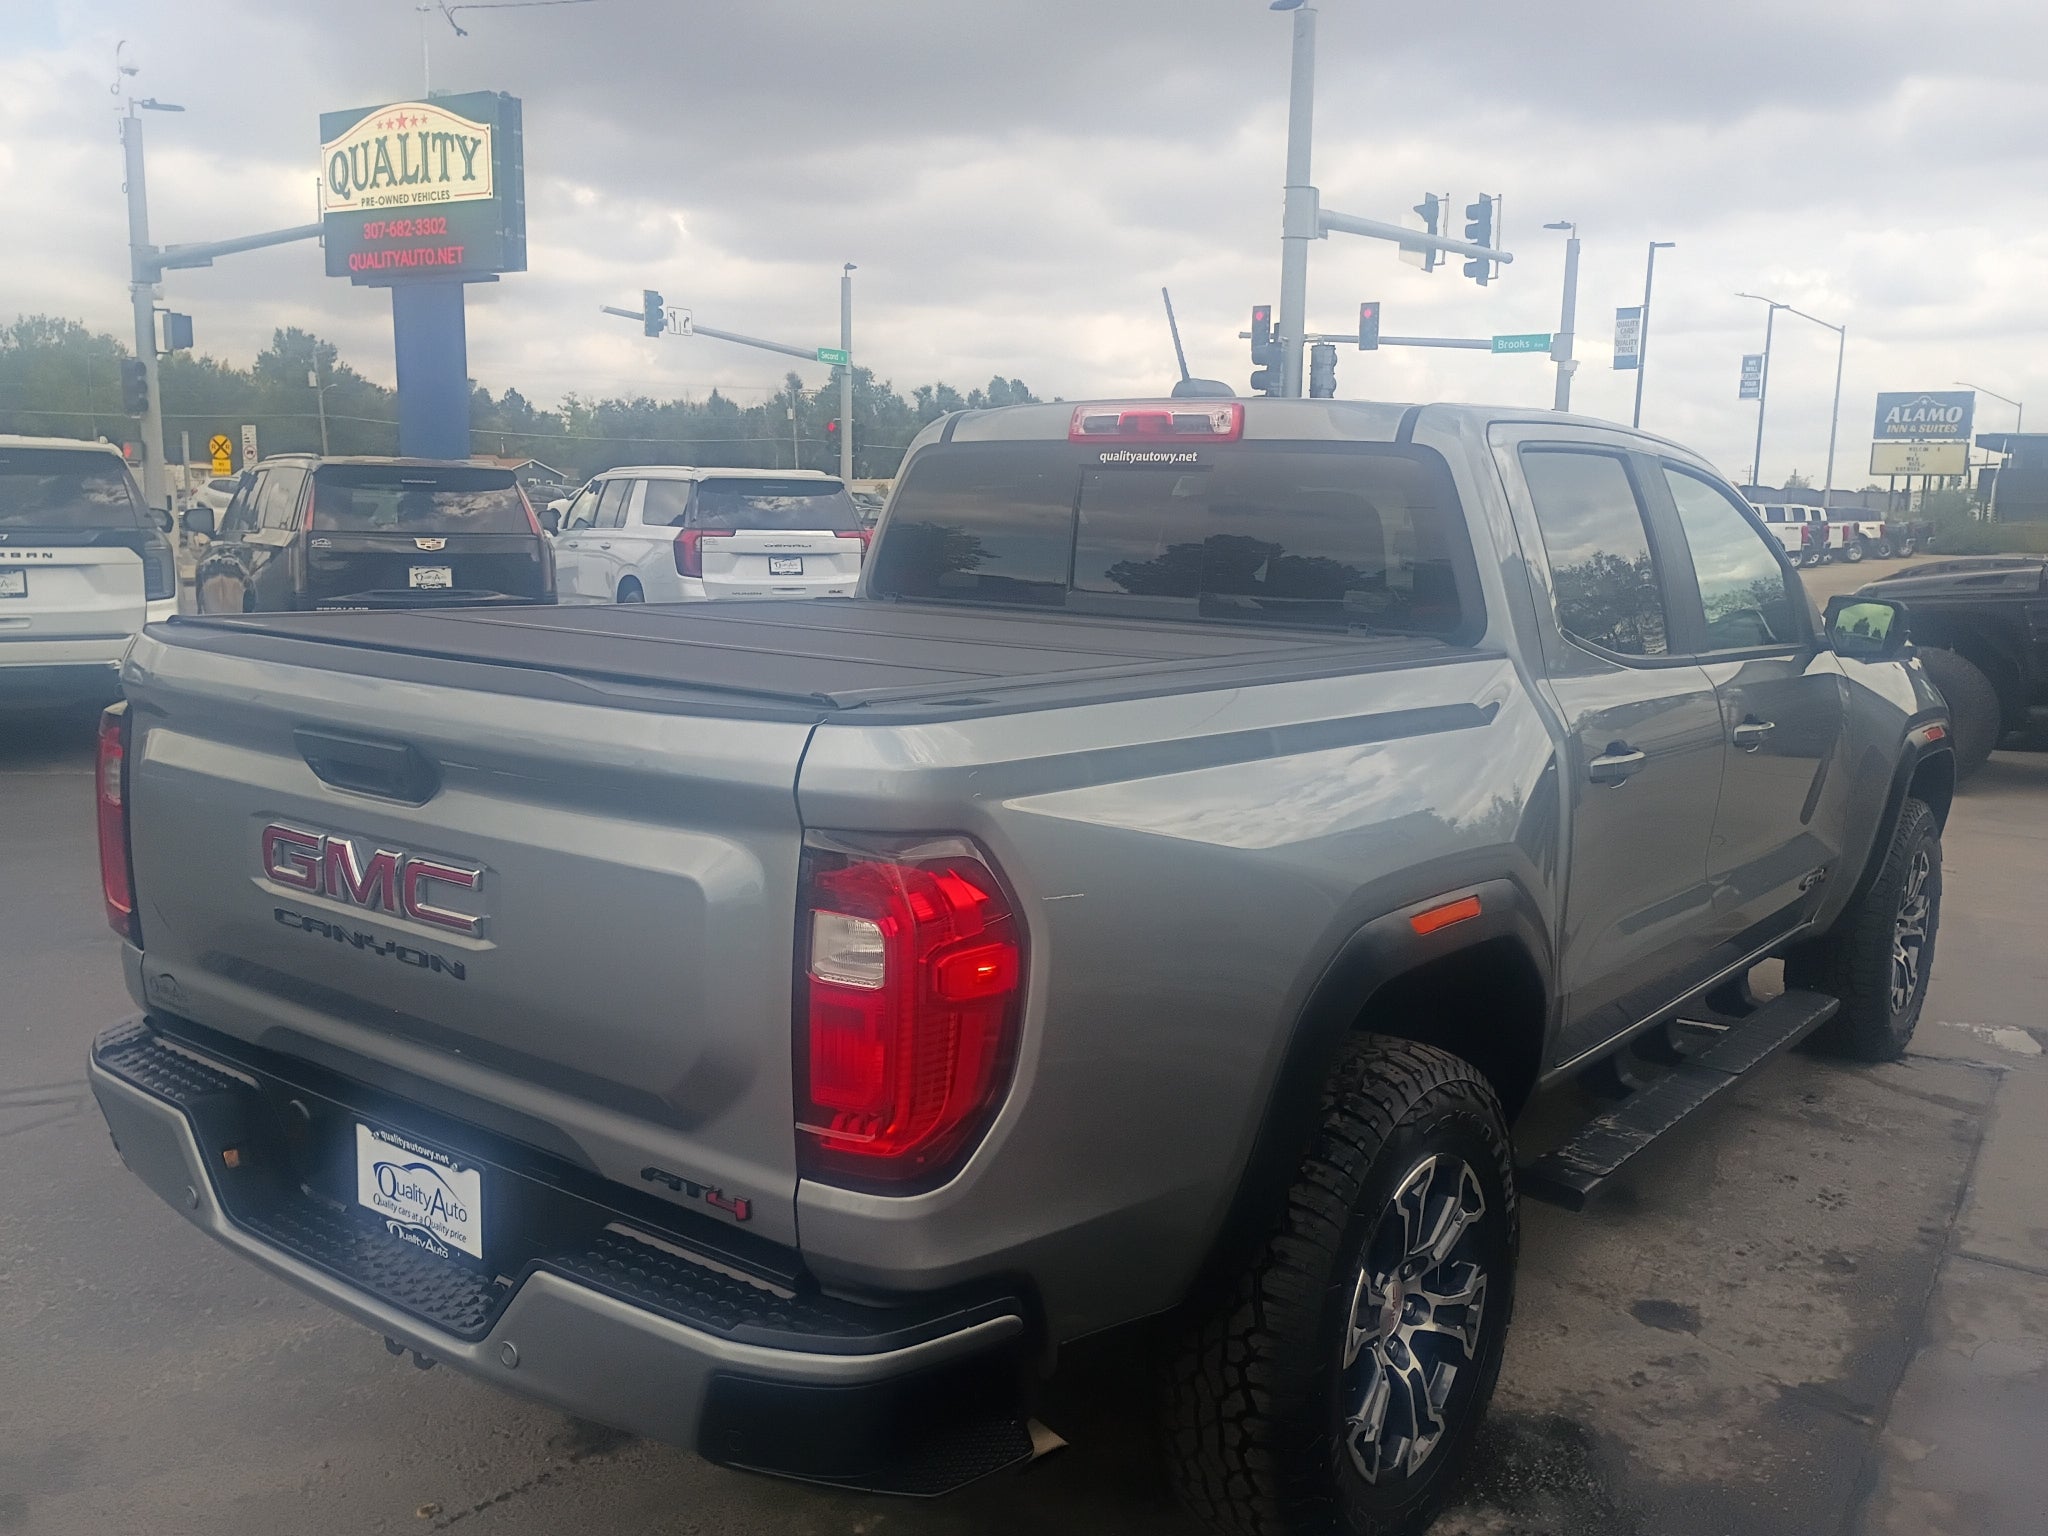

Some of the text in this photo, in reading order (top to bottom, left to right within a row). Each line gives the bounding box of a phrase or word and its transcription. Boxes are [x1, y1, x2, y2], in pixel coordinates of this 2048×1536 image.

[328, 131, 482, 200] QUALITY
[361, 190, 451, 207] PRE-OWNED VEHICLES
[363, 217, 447, 239] 307-682-3302
[349, 246, 464, 271] QUALITYAUTO.NET
[821, 351, 838, 361] Second
[1498, 340, 1530, 349] Brooks
[1885, 406, 1963, 423] ALAMO
[1887, 424, 1959, 433] INN & SUITES
[1100, 450, 1197, 464] qualityautowy.net
[262, 822, 484, 940] GMC
[274, 907, 466, 981] CANYON
[380, 1130, 450, 1164] qualityautowy.net
[641, 1167, 752, 1221] AT4
[373, 1193, 398, 1214] Quality
[398, 1205, 411, 1219] cars
[411, 1213, 418, 1221] at
[424, 1215, 450, 1238] Quality
[450, 1231, 467, 1243] price
